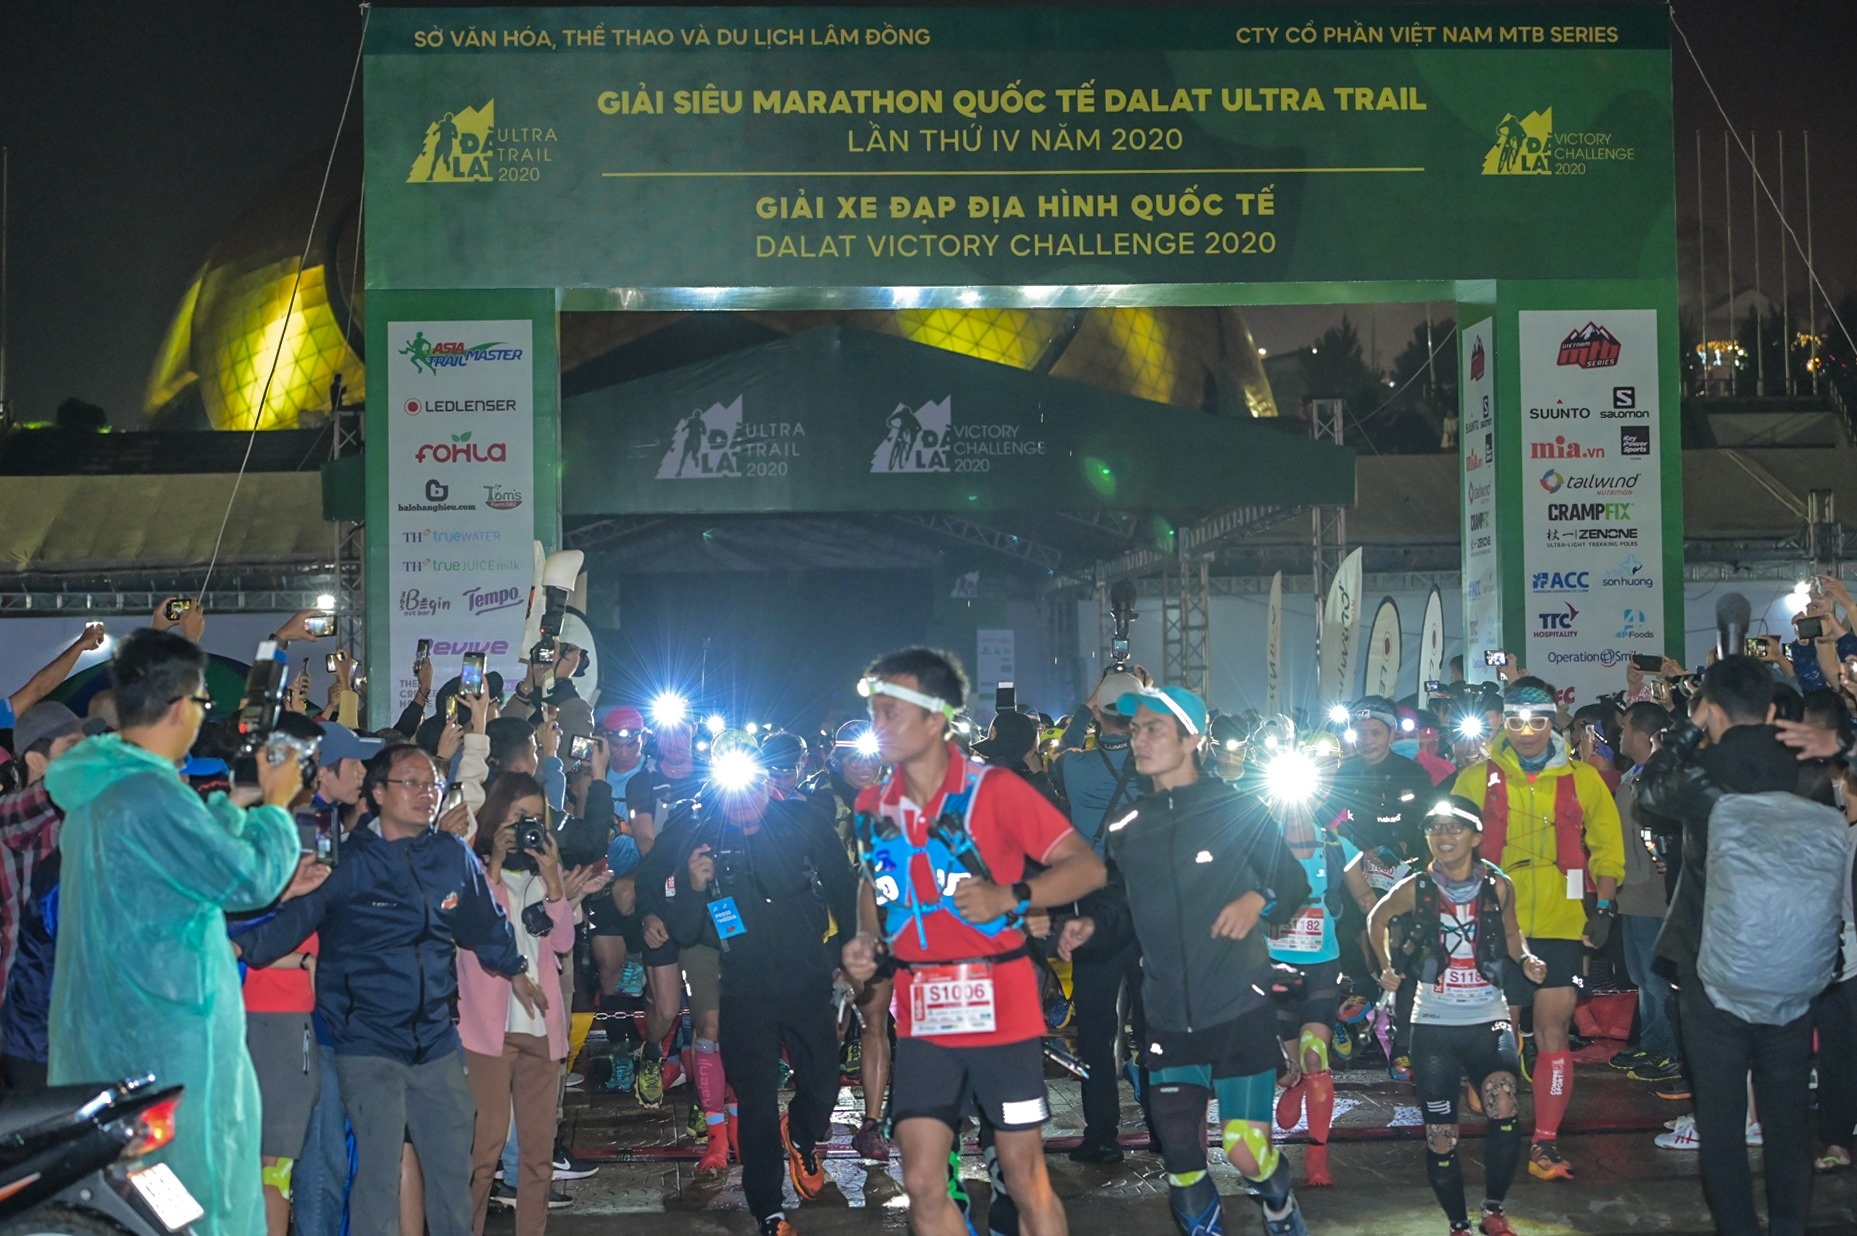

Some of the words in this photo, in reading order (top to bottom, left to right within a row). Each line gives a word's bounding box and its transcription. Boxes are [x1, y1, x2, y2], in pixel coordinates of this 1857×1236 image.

[414, 25, 444, 48] SỞ
[450, 26, 497, 47] VĂN
[503, 26, 557, 49] HÓA,
[563, 22, 605, 46] THỂ
[611, 29, 674, 46] THAO
[680, 24, 710, 46] VÀ
[717, 28, 747, 46] DU
[754, 28, 804, 49] LỊCH
[811, 24, 859, 46] LÂM
[865, 21, 931, 46] ĐỒNG
[1236, 27, 1279, 44] CTY
[1285, 20, 1318, 44] CỔ
[1323, 19, 1384, 43] PHẦN
[1390, 22, 1437, 47] VIỆT
[1442, 26, 1493, 43] NAM
[1499, 26, 1545, 43] MTB
[1550, 26, 1620, 43] SERIES
[598, 82, 664, 115] GIẢI
[673, 83, 743, 115] SIÊU
[753, 89, 943, 114] MARATHON
[953, 79, 1047, 119] QUỐC
[1055, 78, 1095, 113] TẾ
[1105, 87, 1213, 113] DALAT
[1221, 86, 1326, 113] ULTRA
[1334, 85, 1428, 112] TRAIL
[497, 127, 558, 143] ULTRA
[848, 120, 910, 153] LẦN
[919, 122, 983, 152] THỨ
[992, 129, 1021, 152] IV
[1031, 122, 1102, 152] NĂM
[1111, 127, 1184, 151] 2020
[1553, 132, 1613, 146] VICTORY
[497, 148, 553, 163] TRAIL
[1553, 147, 1635, 161] CHALLENGE
[498, 167, 541, 182] 2020
[1554, 162, 1587, 176] 2020
[755, 188, 824, 220] GIẢI
[836, 195, 878, 219] XE
[889, 195, 957, 225] ĐẠP
[967, 195, 1026, 225] ĐỊA
[1038, 188, 1118, 219] HÌNH
[1130, 184, 1224, 222] QUỐC
[1235, 183, 1276, 217] TẾ
[755, 234, 857, 258] DALAT
[867, 233, 1000, 258] VICTORY
[1010, 231, 1195, 257] CHALLENGE
[1204, 230, 1277, 255] 2020
[432, 342, 465, 354] ASIA
[427, 355, 468, 367] TRAIL
[465, 349, 523, 361] MASTER
[425, 399, 517, 413] LEDLENSER
[1529, 407, 1591, 420] SUUNTO
[745, 421, 806, 438] ULTRA
[953, 424, 1020, 439] VICTORY
[744, 442, 801, 457] TRAIL
[953, 440, 1046, 455] CHALLENGE
[1530, 434, 1605, 460] mia.vn
[746, 461, 789, 478] 2020
[954, 458, 991, 473] 2020
[1566, 473, 1640, 490] tailwind
[398, 503, 476, 513] balohanghieu.com
[1547, 502, 1633, 521] CRAMPFIX
[402, 531, 423, 543] TH
[1578, 528, 1639, 540] ZENONE
[402, 560, 423, 573] TH
[1550, 571, 1590, 589] ACC
[462, 586, 520, 611] Tempo
[1539, 613, 1573, 629] TTC
[1547, 651, 1600, 665] Operation
[400, 679, 419, 688] THE
[928, 983, 986, 1002] S1006
